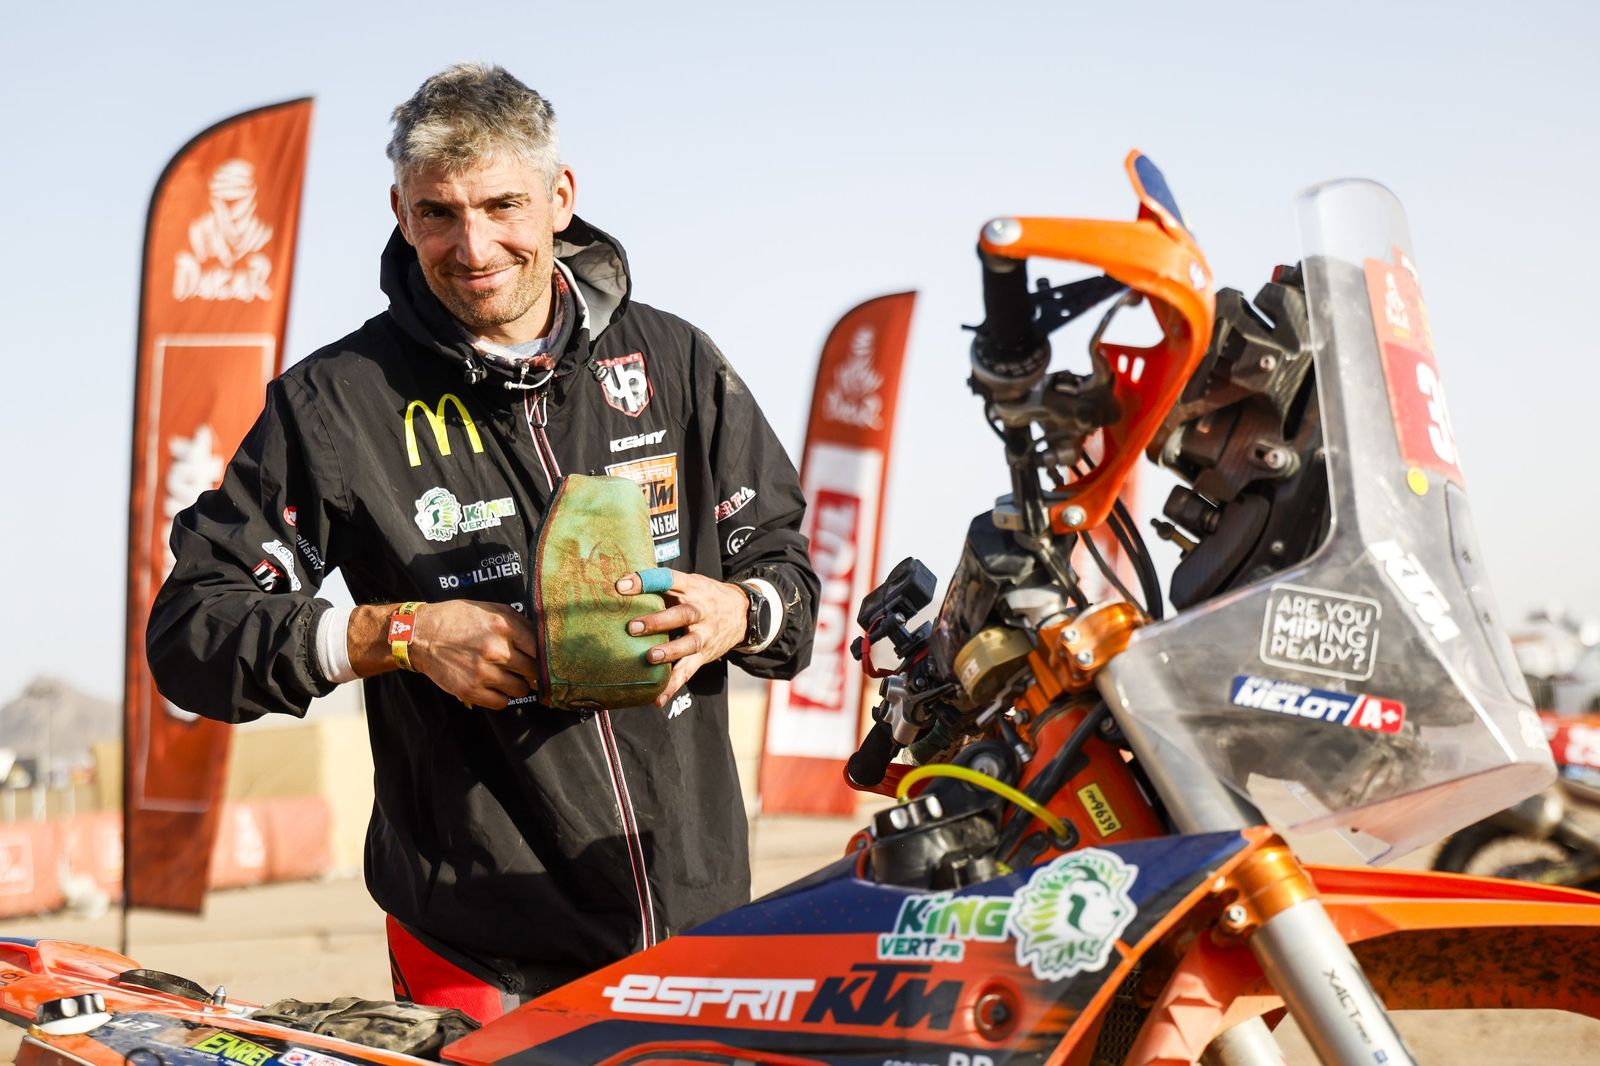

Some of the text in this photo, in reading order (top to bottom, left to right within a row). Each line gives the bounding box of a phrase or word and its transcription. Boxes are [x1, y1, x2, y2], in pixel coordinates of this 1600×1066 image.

[1416, 361, 1458, 466] 3
[641, 480, 675, 508] TM
[1276, 594, 1372, 628] ARE YOU
[1233, 681, 1350, 722] MELOT
[802, 963, 964, 1031] KTM
